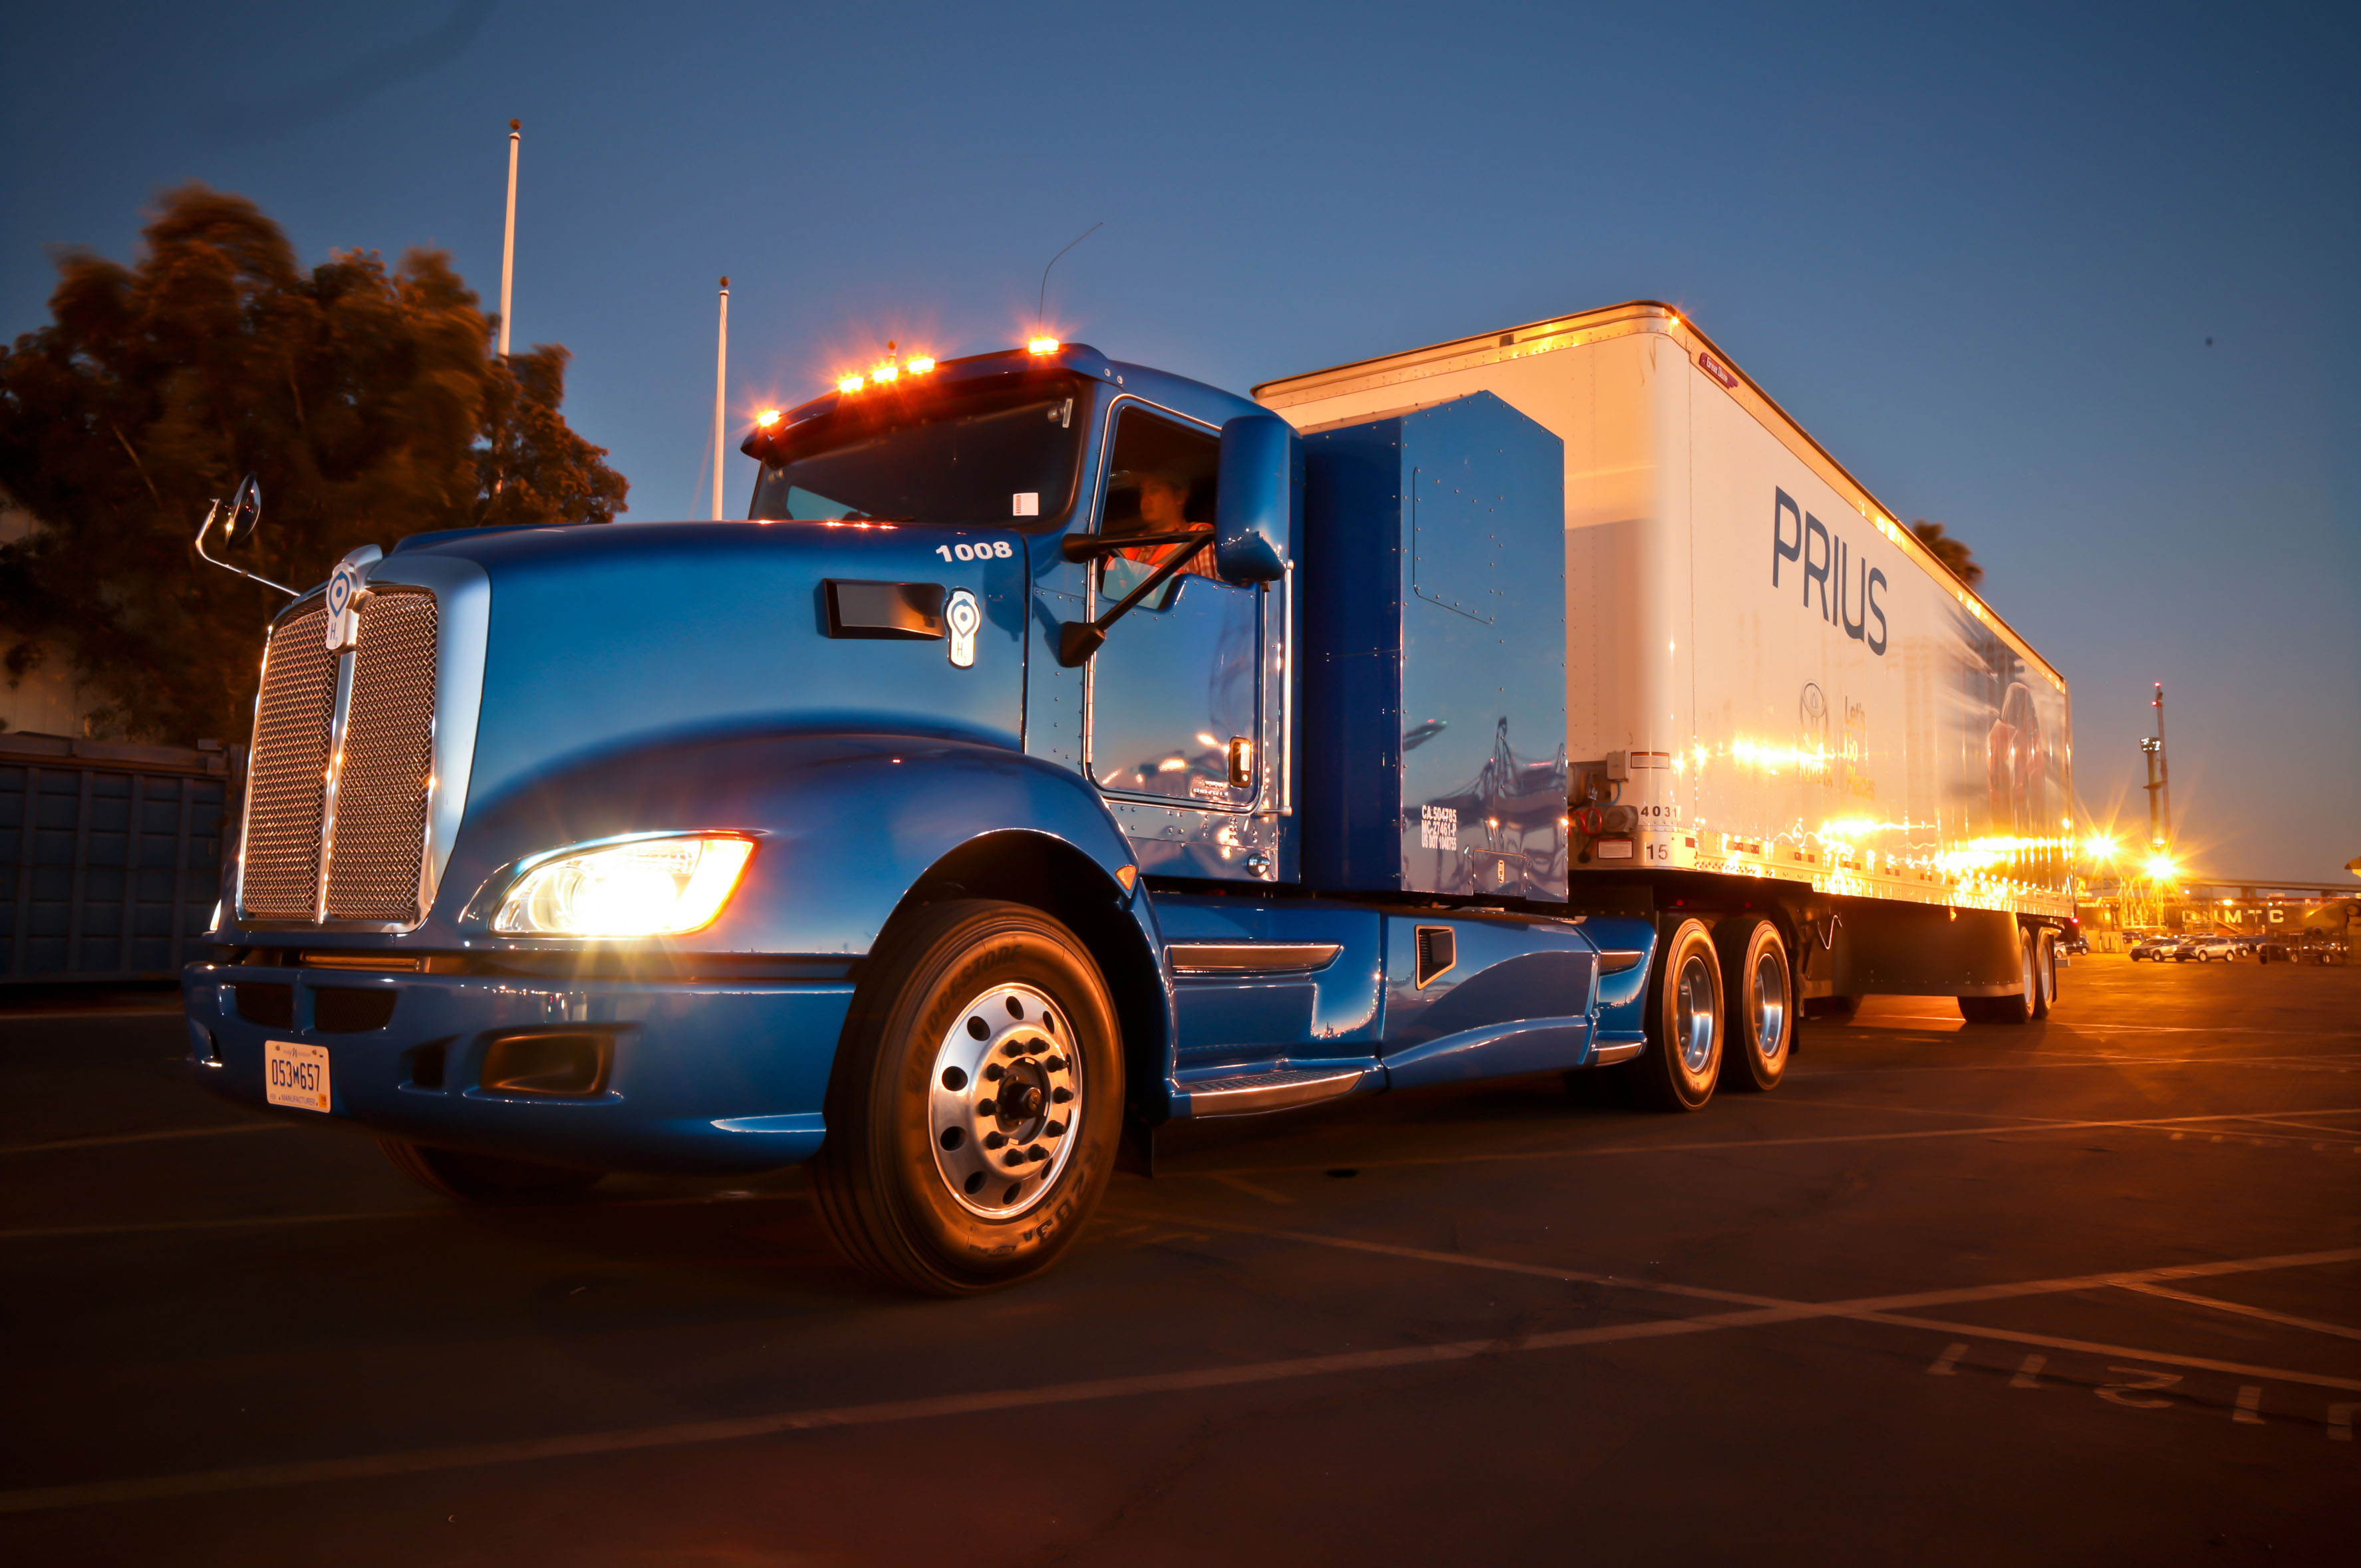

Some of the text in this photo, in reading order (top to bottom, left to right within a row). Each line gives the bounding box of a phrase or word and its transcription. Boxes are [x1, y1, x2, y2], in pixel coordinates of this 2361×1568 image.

[271, 394, 321, 426] 053M657
[281, 429, 315, 441] MANUFACTURER
[936, 541, 1012, 562] 1008
[1772, 485, 1887, 656] PRIUS
[1647, 844, 1668, 860] 15
